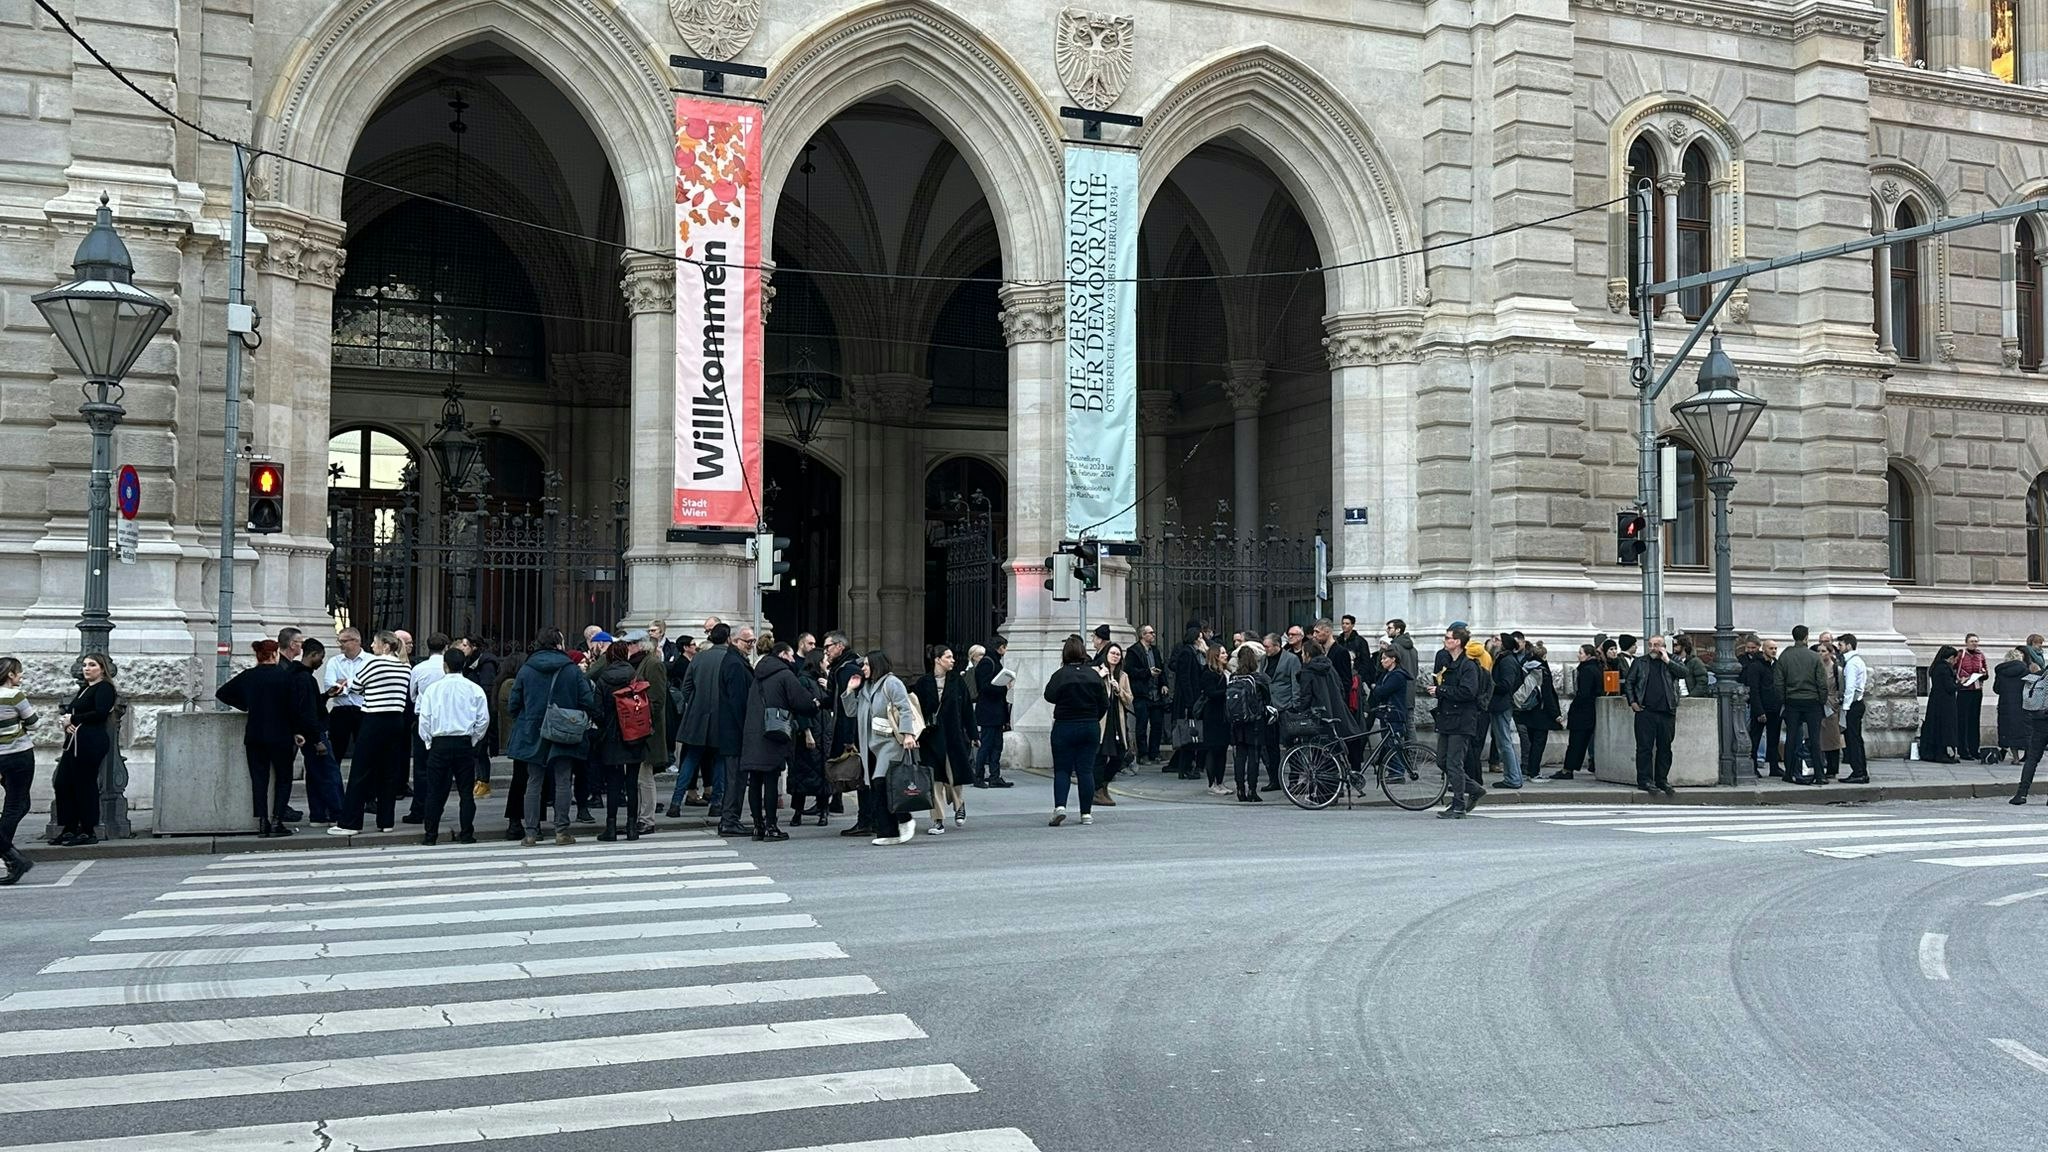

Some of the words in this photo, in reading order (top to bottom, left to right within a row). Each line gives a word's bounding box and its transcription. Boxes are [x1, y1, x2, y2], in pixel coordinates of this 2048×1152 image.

[1109, 186, 1119, 208] 1934
[1108, 210, 1118, 261] FEBRUAR
[1067, 179, 1089, 360] ZERSTÖRUNG
[1087, 173, 1107, 352] DEMOKRATIE
[1108, 263, 1116, 280] BIS
[1107, 281, 1117, 304] 1933
[1106, 306, 1116, 337] MÄRZ
[693, 241, 727, 481] Willkommen
[1070, 366, 1087, 412] DIE
[1086, 359, 1104, 414] DER
[682, 498, 708, 508] Stadt
[682, 508, 708, 517] Wien
[1353, 509, 1358, 518] 1
